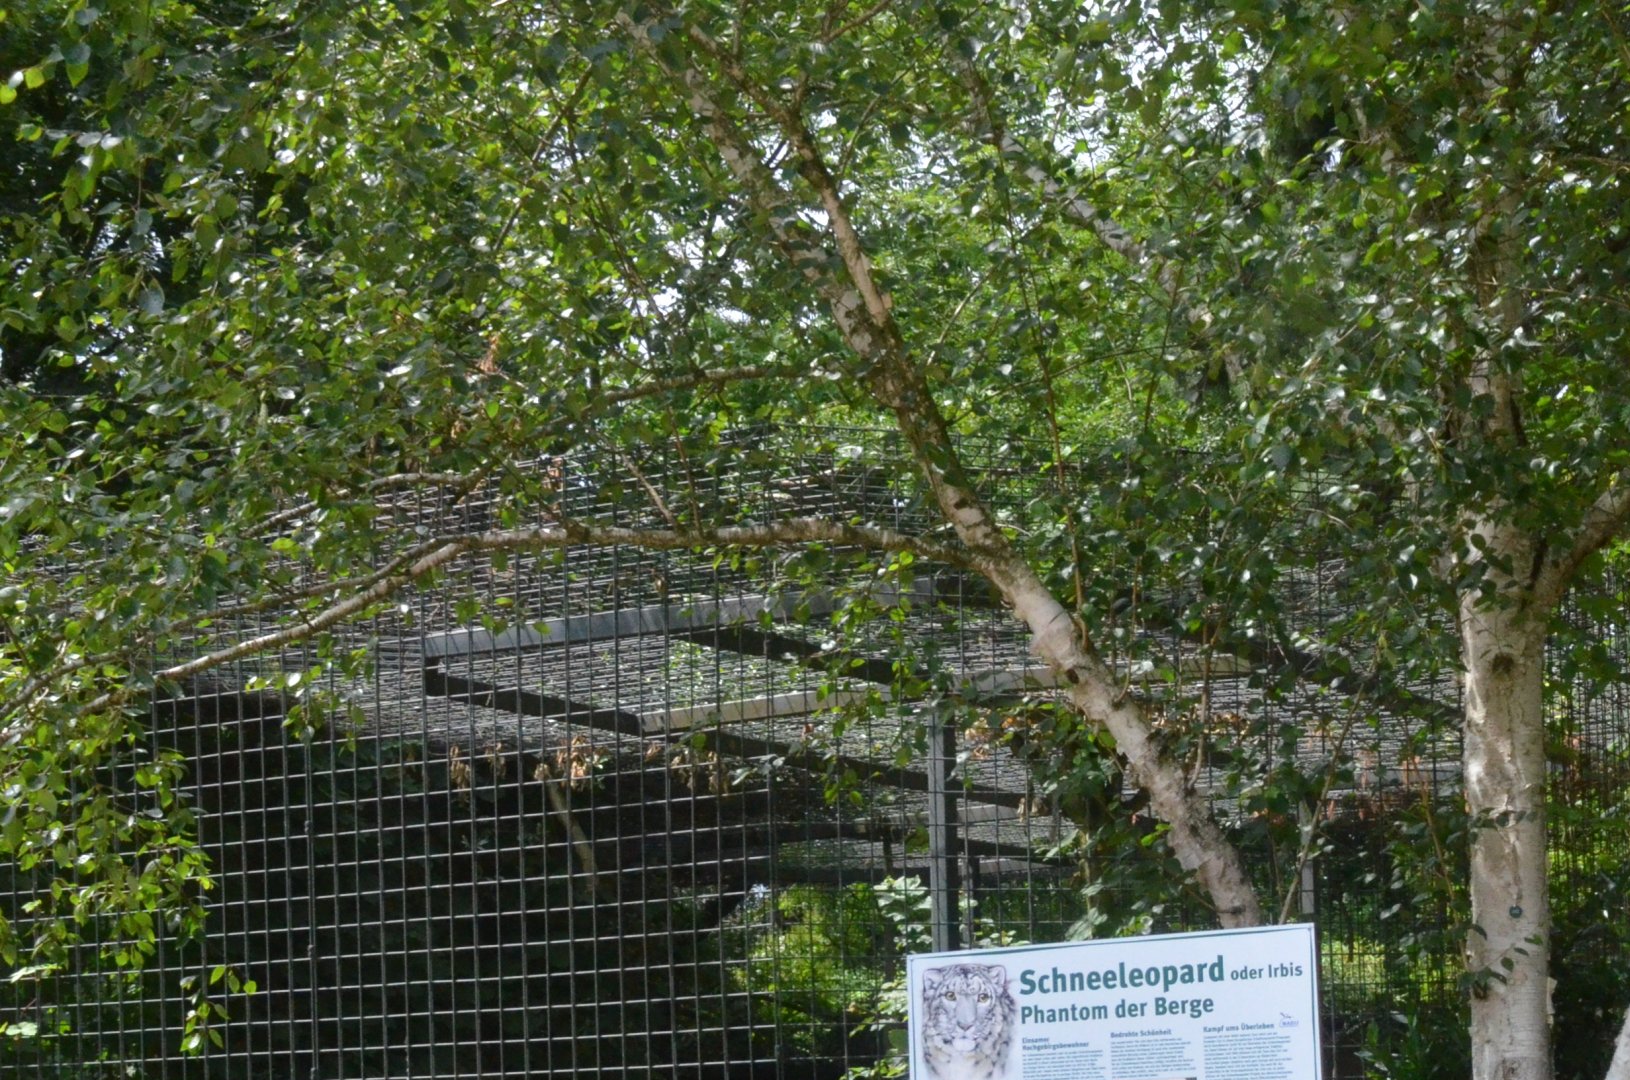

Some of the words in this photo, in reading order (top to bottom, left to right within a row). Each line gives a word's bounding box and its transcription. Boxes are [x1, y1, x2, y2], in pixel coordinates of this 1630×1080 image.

[1020, 955, 1224, 995] Schneeleopard
[1230, 966, 1264, 981] oder
[1268, 962, 1303, 978] Irbis
[1021, 1003, 1108, 1024] Phantom
[1115, 998, 1147, 1018] der
[1154, 997, 1214, 1018] Berge
[1203, 1025, 1224, 1033] Kampf
[1241, 1022, 1275, 1030] Überleben
